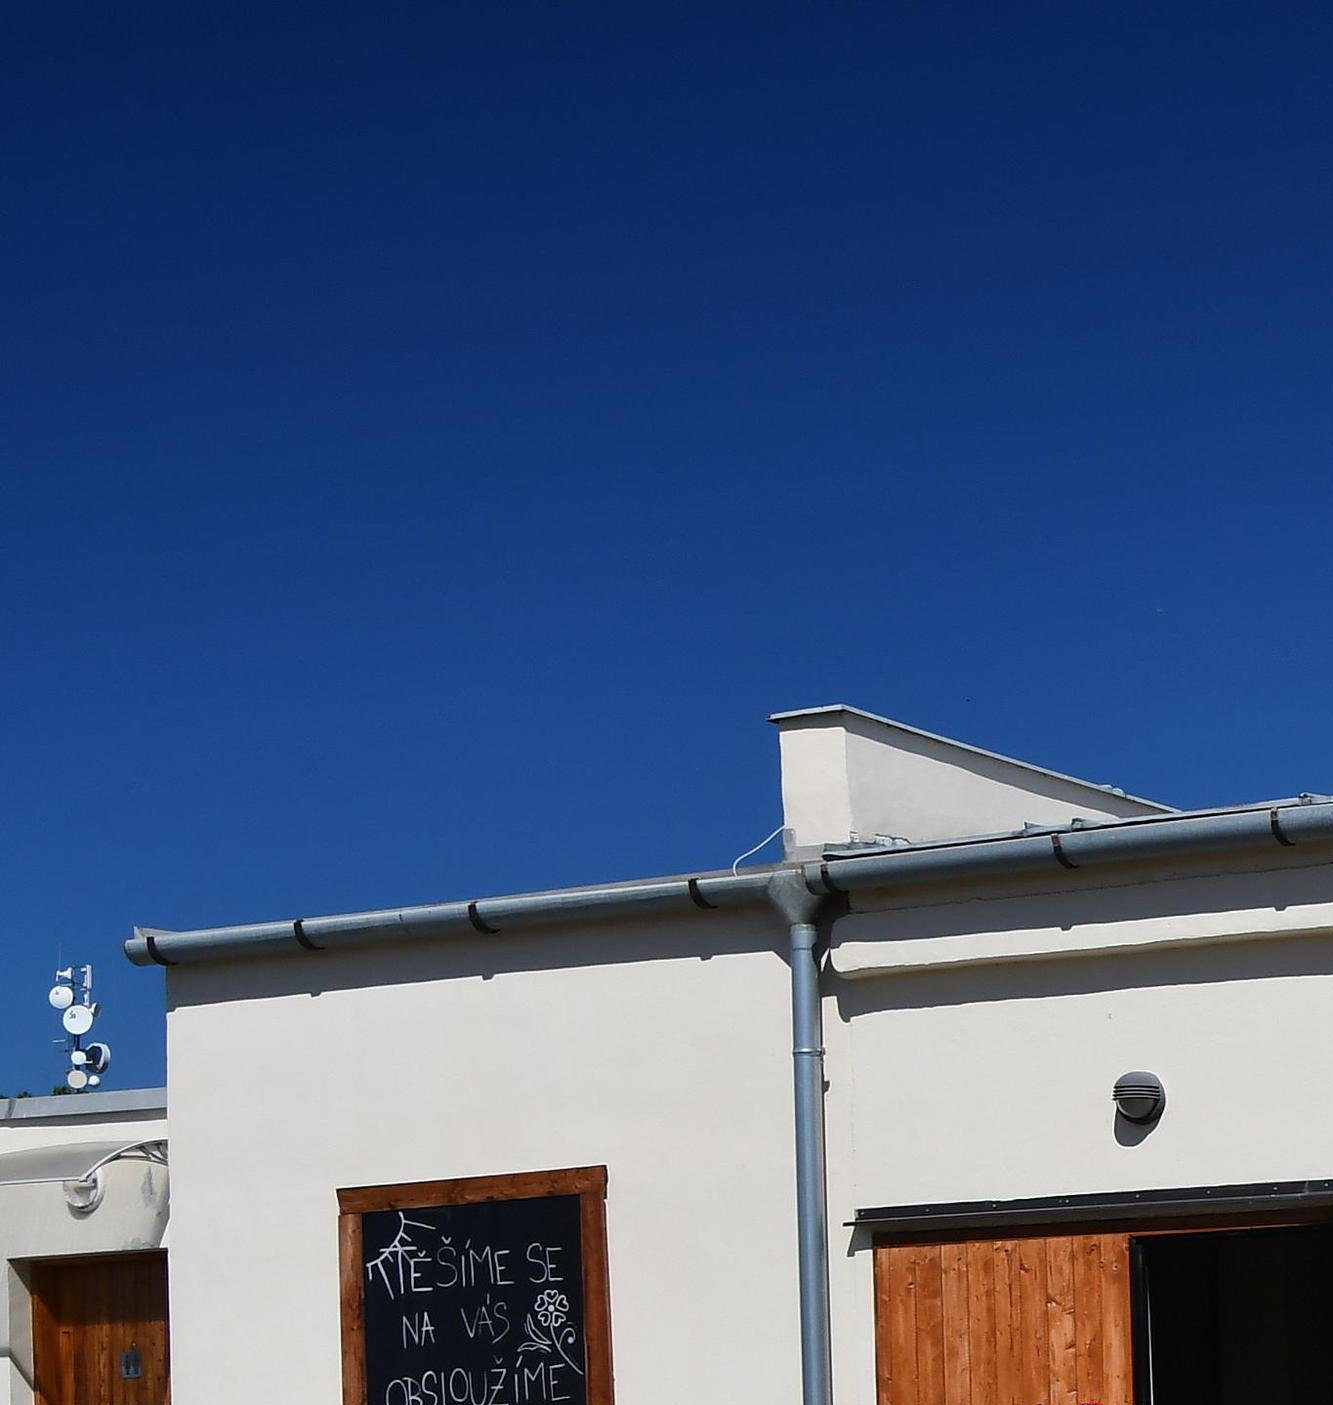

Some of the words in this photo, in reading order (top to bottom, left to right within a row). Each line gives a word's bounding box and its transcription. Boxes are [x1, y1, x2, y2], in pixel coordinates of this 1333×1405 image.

[378, 1235, 515, 1295] TĚŠÍME
[525, 1241, 564, 1284] SE
[402, 1310, 436, 1349] NA
[460, 1294, 511, 1344] VÁS
